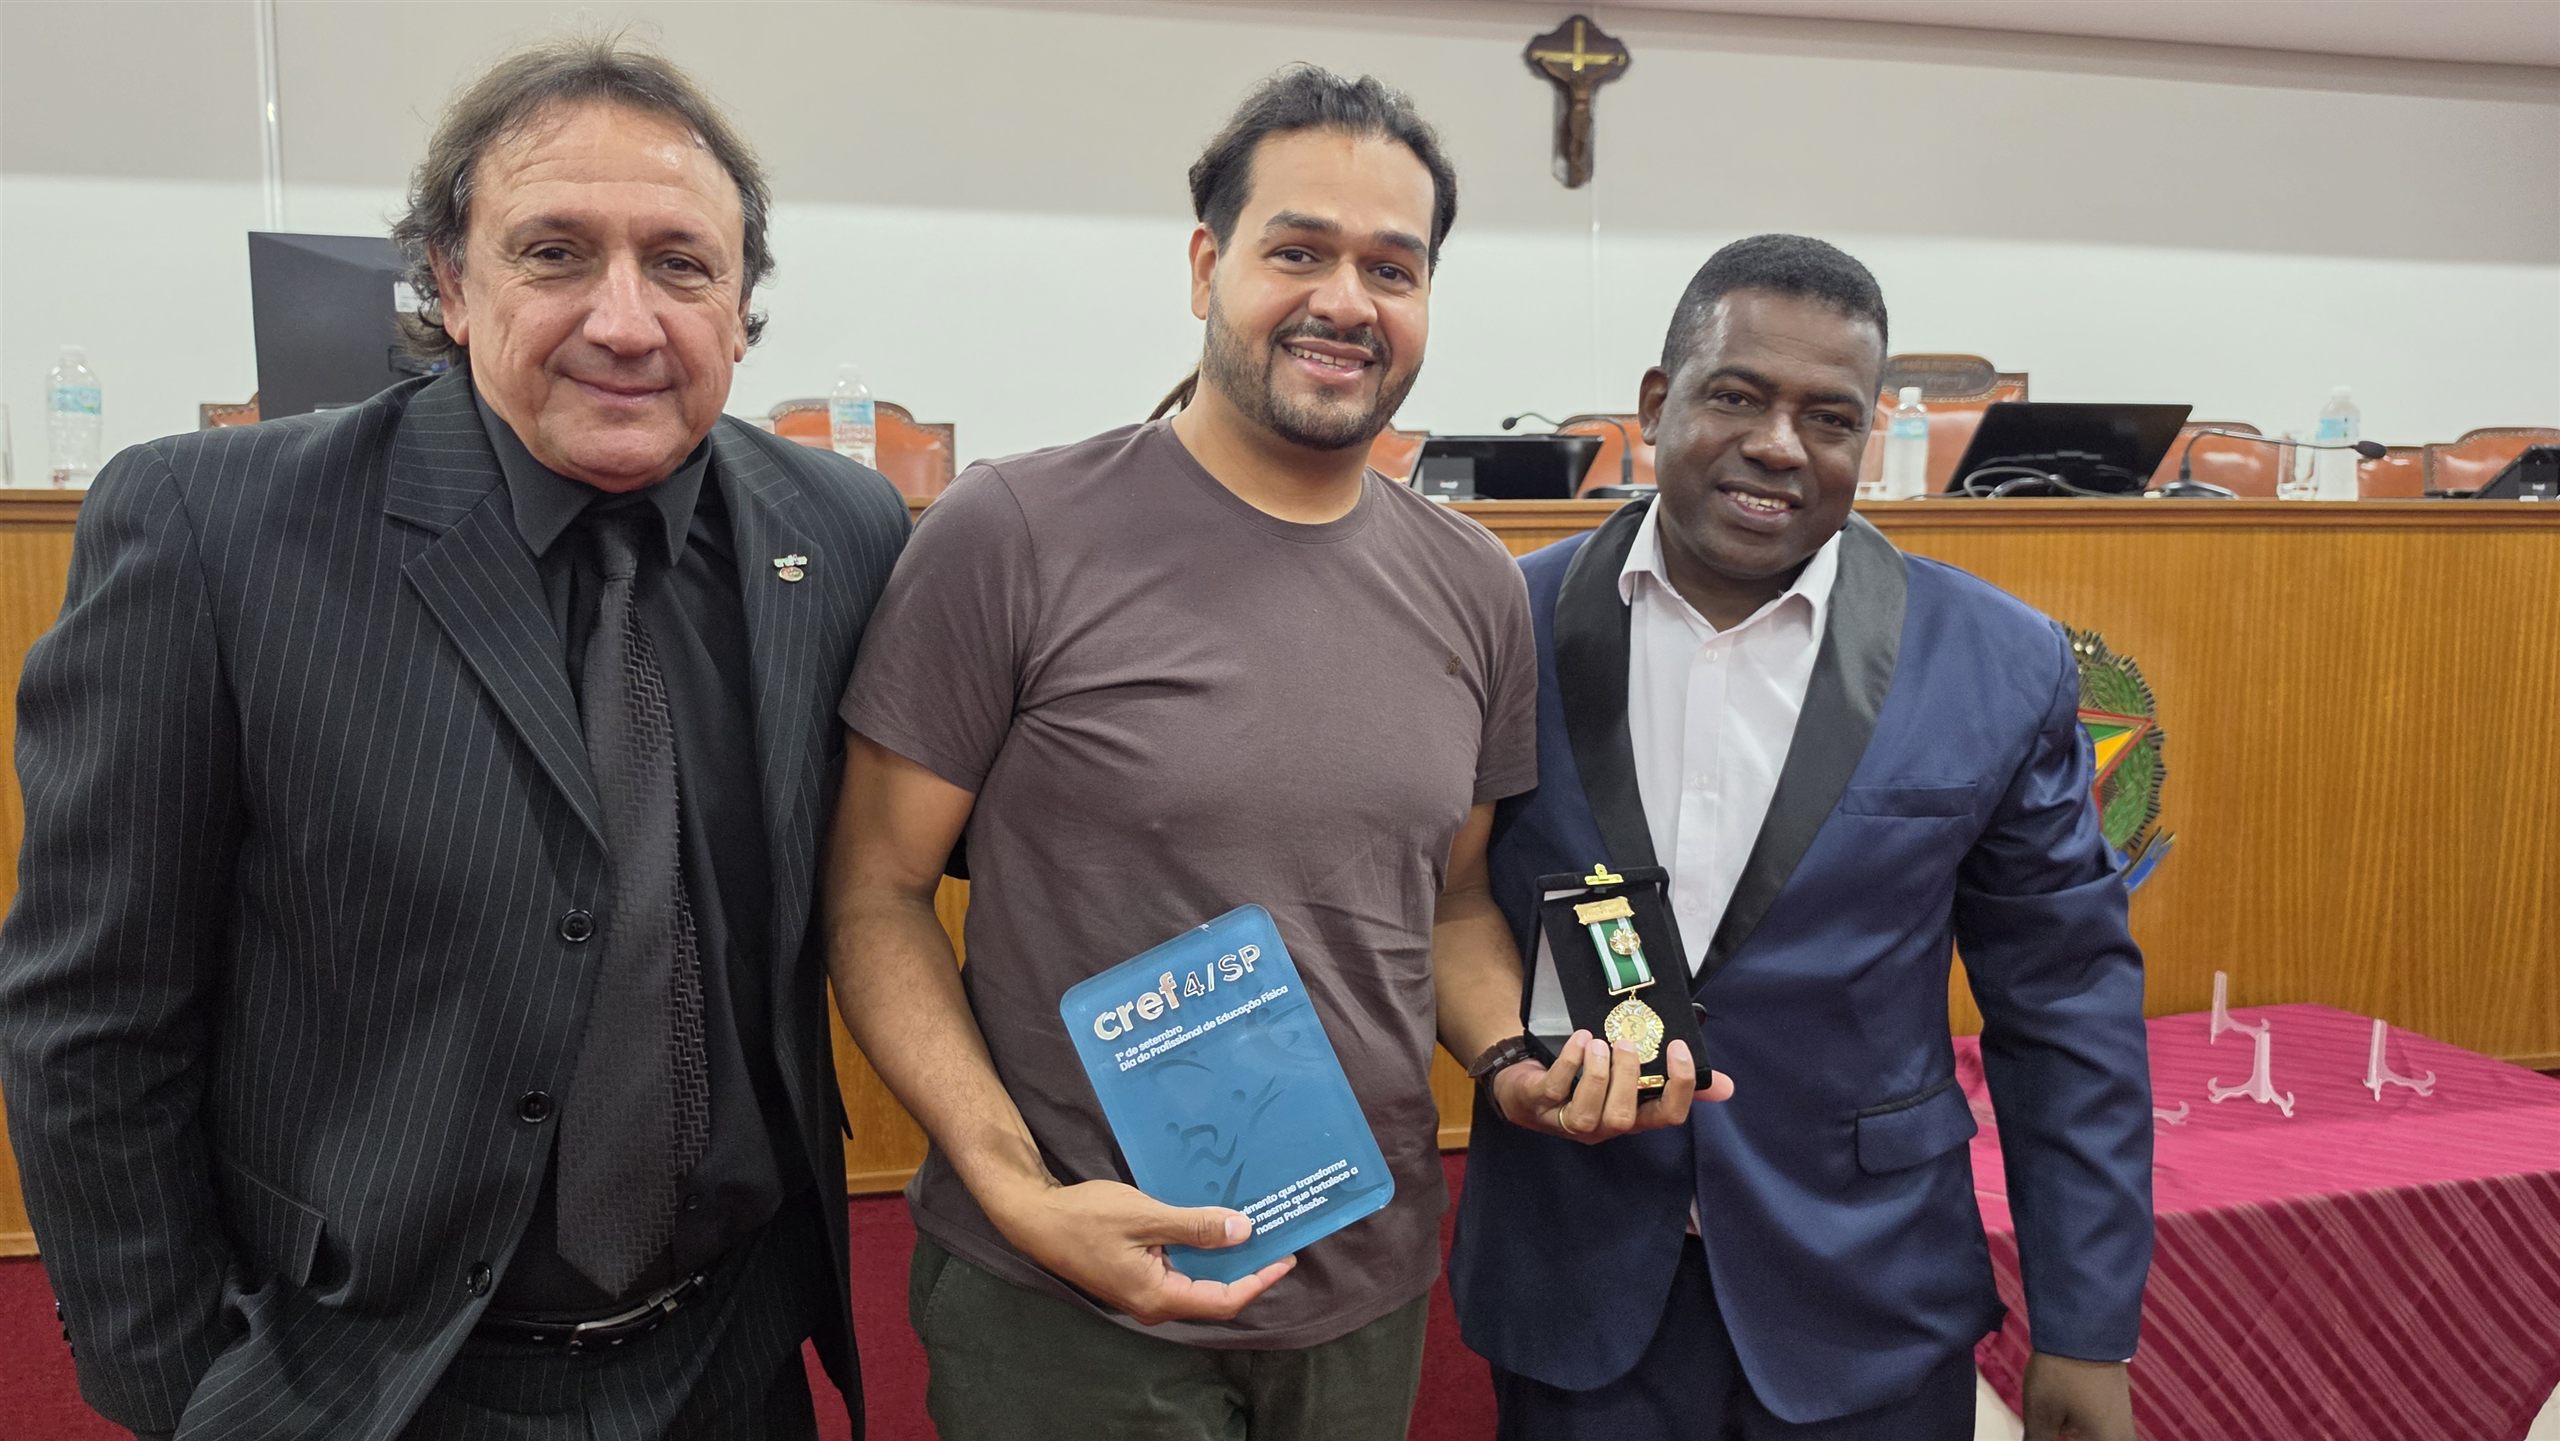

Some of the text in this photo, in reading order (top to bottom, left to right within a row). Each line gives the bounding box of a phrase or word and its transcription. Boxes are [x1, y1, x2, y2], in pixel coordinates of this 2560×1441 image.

[1119, 985, 1289, 1073] Dia do Profissional de Educação Física
[1124, 1046, 1139, 1058] de
[1138, 1025, 1184, 1051] setembro
[1240, 1159, 1348, 1216] vimento que transforma
[1256, 1200, 1292, 1224] mesmo
[1291, 1191, 1311, 1206] que
[1309, 1173, 1351, 1197] fortalece
[1350, 1166, 1359, 1175] a
[1256, 1216, 1285, 1236] nossa
